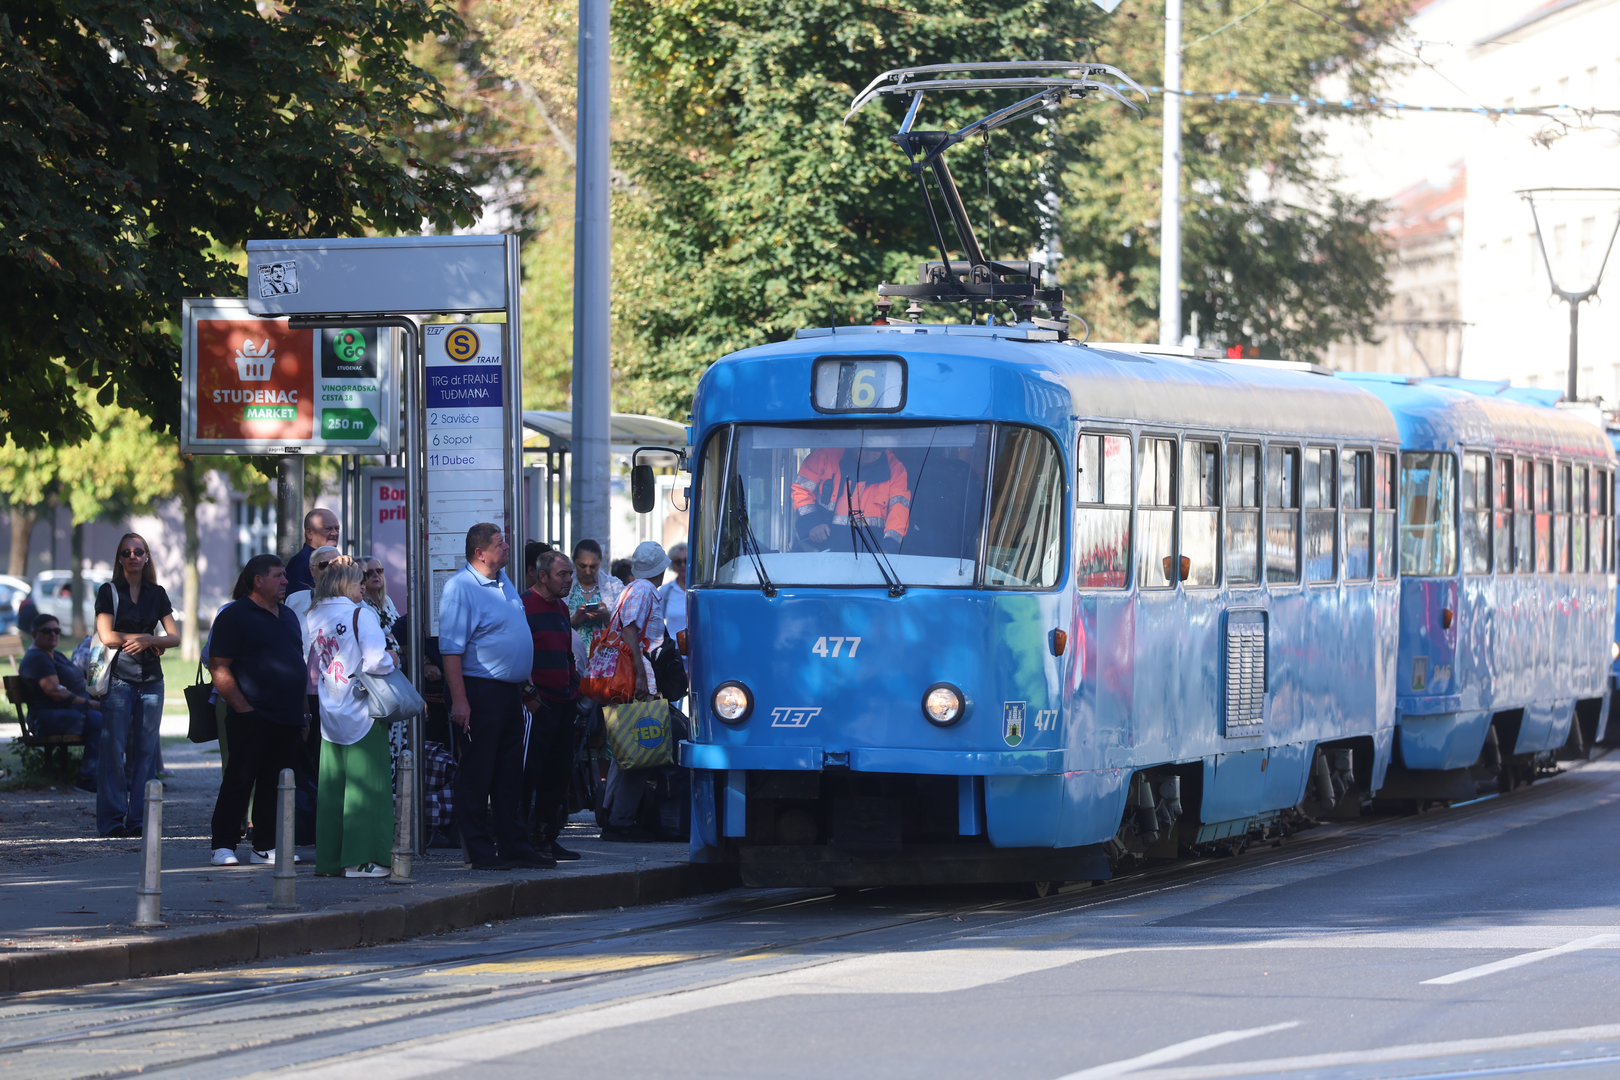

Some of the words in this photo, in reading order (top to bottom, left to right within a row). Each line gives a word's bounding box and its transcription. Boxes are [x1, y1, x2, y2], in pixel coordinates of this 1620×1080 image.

[336, 333, 355, 345] TO
[454, 334, 470, 355] S
[343, 346, 366, 358] GO
[431, 376, 448, 386] TRG
[451, 375, 461, 385] dr.
[463, 373, 499, 384] FRANJE
[440, 388, 490, 400] TUĐMANA
[851, 369, 876, 408] 6
[213, 389, 298, 403] STUDENAC
[247, 408, 294, 418] MARKET
[430, 412, 438, 425] 2
[441, 413, 480, 424] Savišće
[328, 418, 350, 430] 250
[352, 421, 364, 430] m
[432, 434, 440, 446] 6
[443, 434, 473, 446] Sopot
[429, 454, 439, 466] 11
[442, 455, 475, 465] Dubec
[812, 636, 862, 658] 477
[771, 707, 822, 727] ZET
[1034, 709, 1059, 731] 477
[630, 724, 666, 741] TEDi
